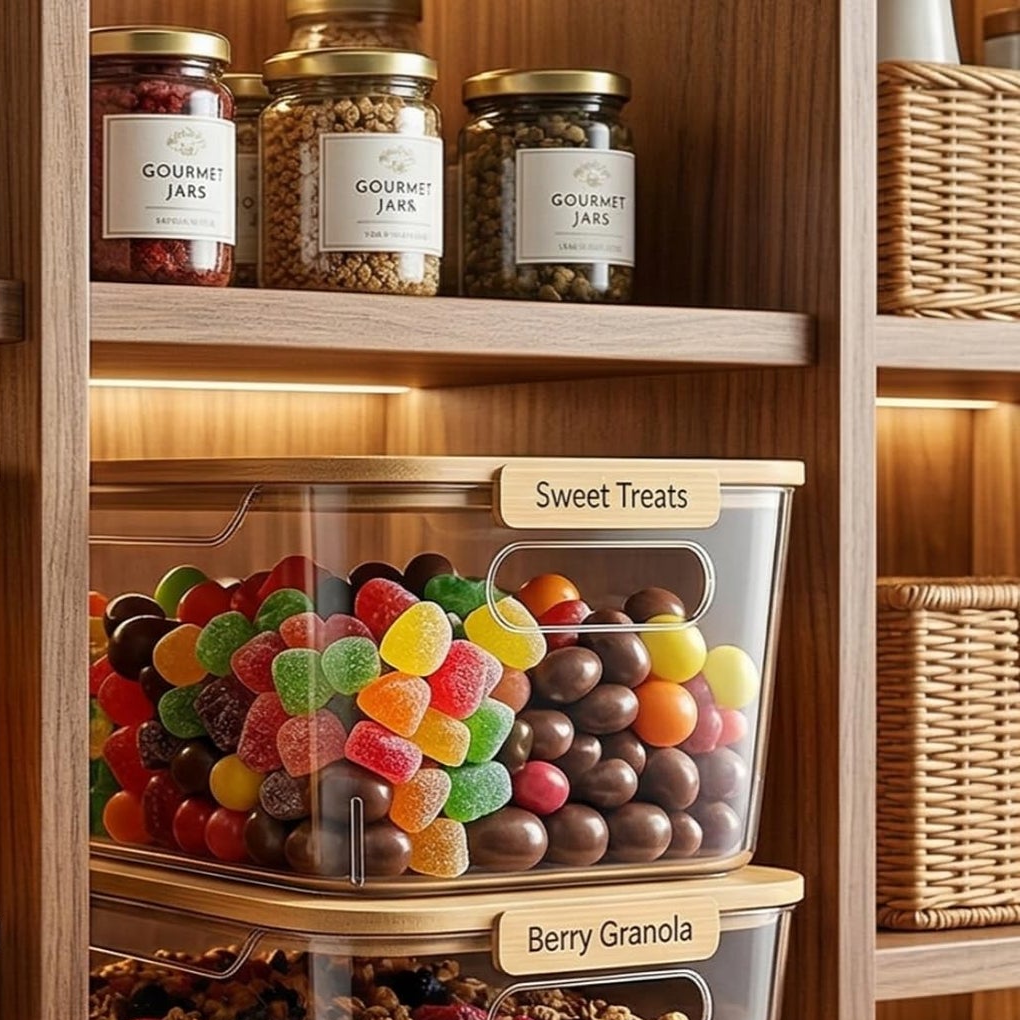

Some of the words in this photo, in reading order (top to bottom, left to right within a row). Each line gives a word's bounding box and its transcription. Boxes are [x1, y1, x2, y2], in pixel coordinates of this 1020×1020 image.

[142, 163, 224, 182] GOURMET
[165, 184, 207, 201] JARS
[355, 180, 432, 196] GOURMET
[551, 193, 626, 210] GOURMET
[572, 211, 610, 228] JARS
[536, 480, 610, 509] Sweet
[616, 482, 688, 509] Treats
[528, 925, 592, 957] Berry
[600, 914, 693, 948] Granola
